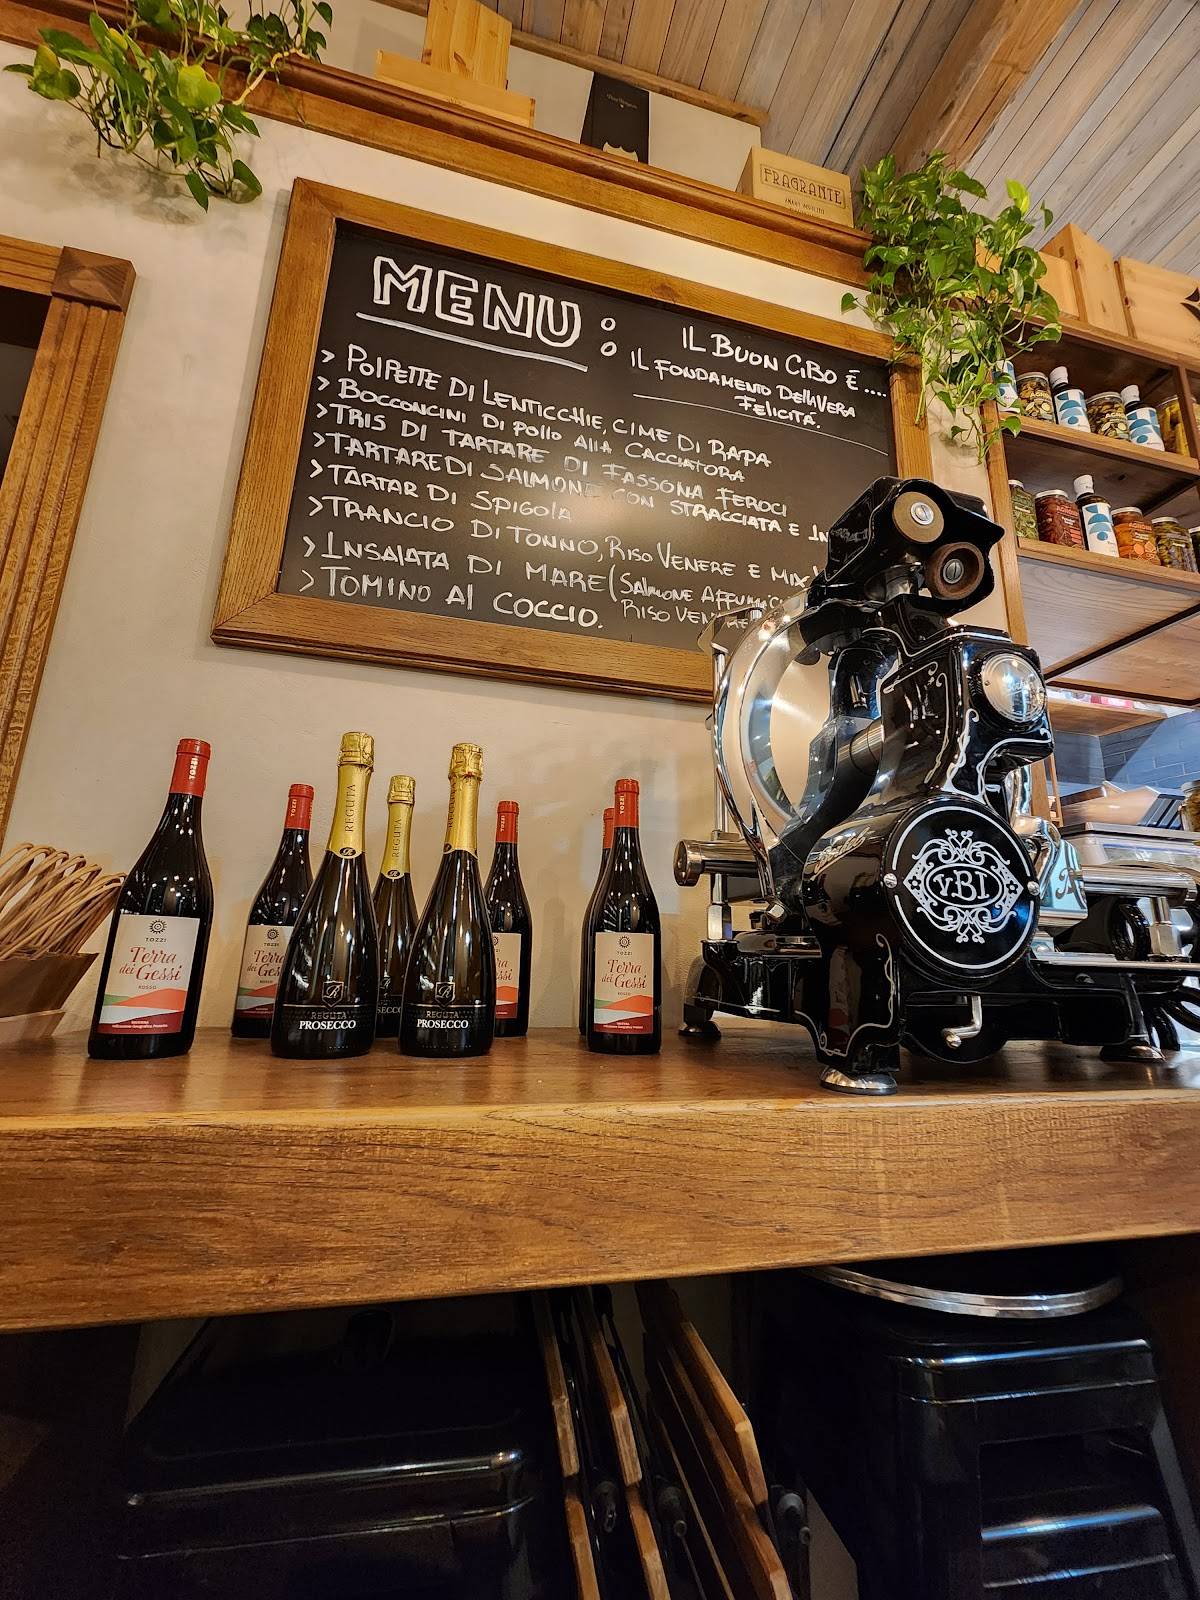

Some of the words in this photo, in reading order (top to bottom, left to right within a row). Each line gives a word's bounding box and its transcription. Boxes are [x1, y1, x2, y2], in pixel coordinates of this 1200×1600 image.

[763, 167, 842, 205] FRAGRANTE
[373, 255, 582, 348] MENU
[682, 325, 707, 352] IL
[710, 333, 779, 371] BUON
[630, 347, 650, 371] IL
[653, 359, 772, 396] FONDAMENTO
[816, 395, 856, 418] VERA
[337, 377, 467, 424] BOCCONCINI
[481, 412, 505, 431] DI
[624, 442, 745, 483] CACCIATORA
[448, 376, 475, 402] DI
[612, 418, 672, 444] CIME
[677, 433, 701, 455] DI
[708, 439, 772, 468] RAPA
[328, 402, 387, 431] TRIS
[401, 419, 428, 442] DI
[441, 429, 551, 464] TARTARE
[563, 455, 588, 476] DI
[601, 463, 704, 500] FASSONA
[715, 487, 787, 517] FEROCI
[325, 432, 442, 471] TARTARE
[444, 455, 473, 477] DI
[670, 500, 782, 533] STRACCIATA
[789, 522, 800, 537] E
[327, 464, 419, 498] TARTAR
[427, 483, 457, 505] DI
[321, 495, 455, 532] TRANCIO
[470, 518, 500, 540] DI
[605, 535, 652, 563] RISO
[657, 542, 737, 577] VENERE
[748, 563, 761, 579] E
[770, 566, 811, 588] MIX
[320, 566, 432, 602] TOMINO
[467, 554, 501, 576] DI
[525, 561, 607, 593] MARE
[620, 598, 670, 622] RISO
[345, 784, 356, 832] REGUTA
[392, 818, 402, 858] REGUTA
[119, 963, 136, 975] dei
[135, 963, 183, 981] Gessi
[130, 946, 177, 964] Terra
[257, 963, 281, 977] Ges
[607, 959, 642, 974] Terra
[600, 974, 613, 983] dei
[614, 974, 648, 989] Gessi
[299, 1019, 357, 1030] PROSECCO
[416, 1019, 469, 1029] PROSECCO
[426, 1010, 459, 1019] REGUTA
